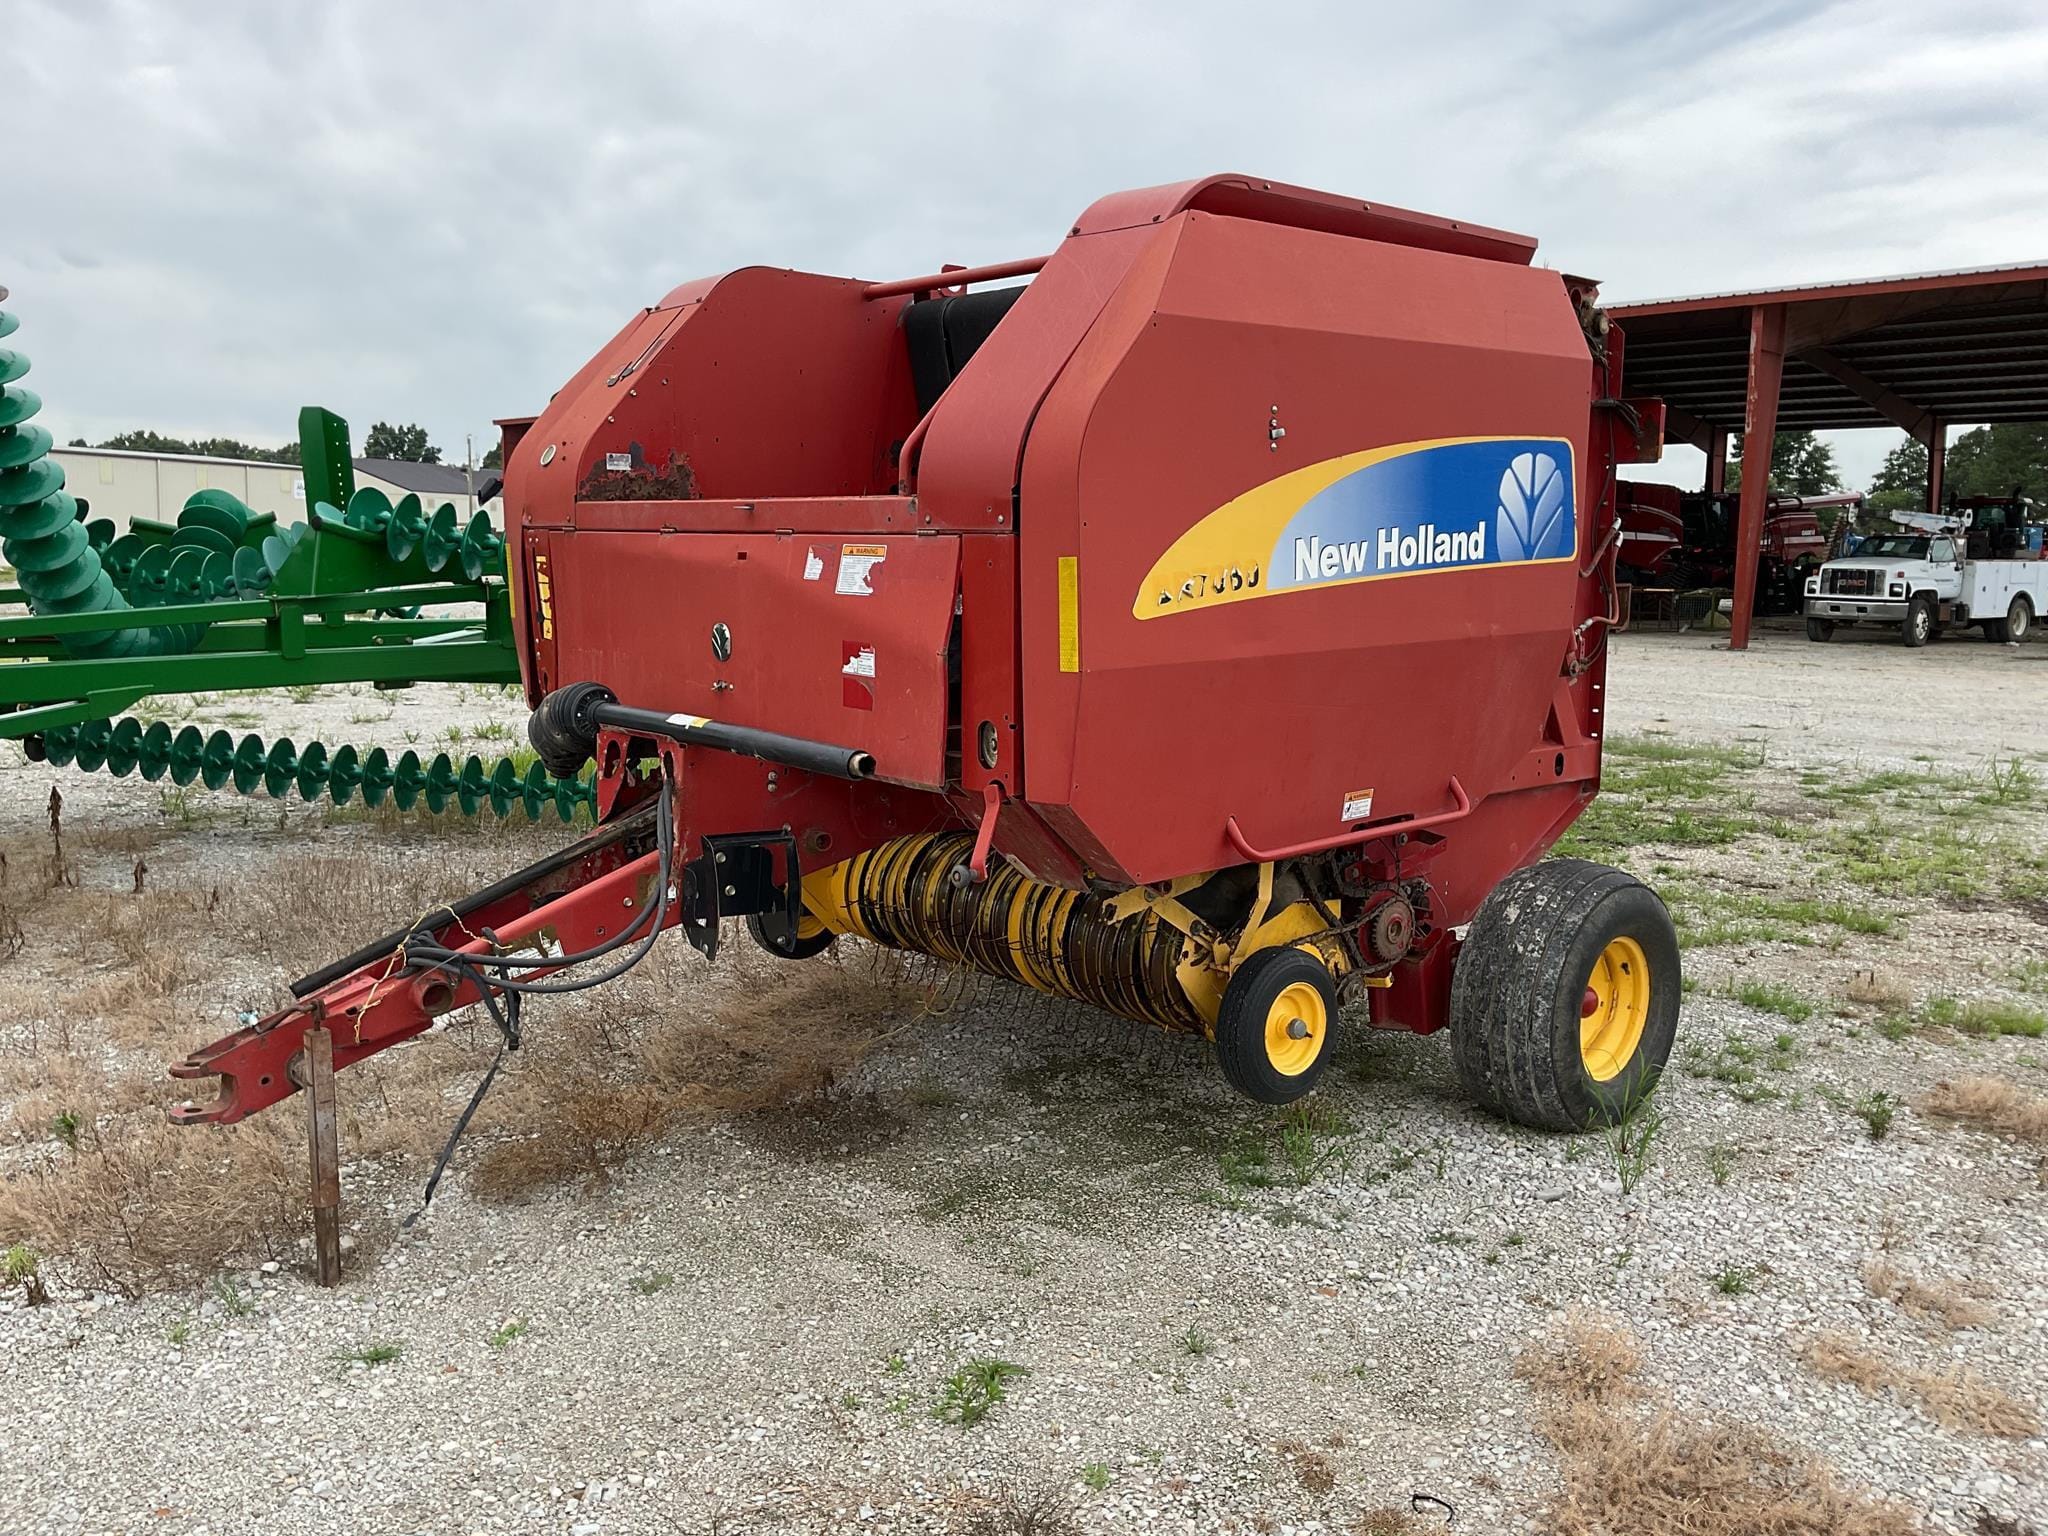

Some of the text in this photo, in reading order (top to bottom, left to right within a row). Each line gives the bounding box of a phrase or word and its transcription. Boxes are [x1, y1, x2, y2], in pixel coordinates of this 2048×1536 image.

[1294, 520, 1486, 582] New Holland
[1839, 578, 1866, 587] GMC
